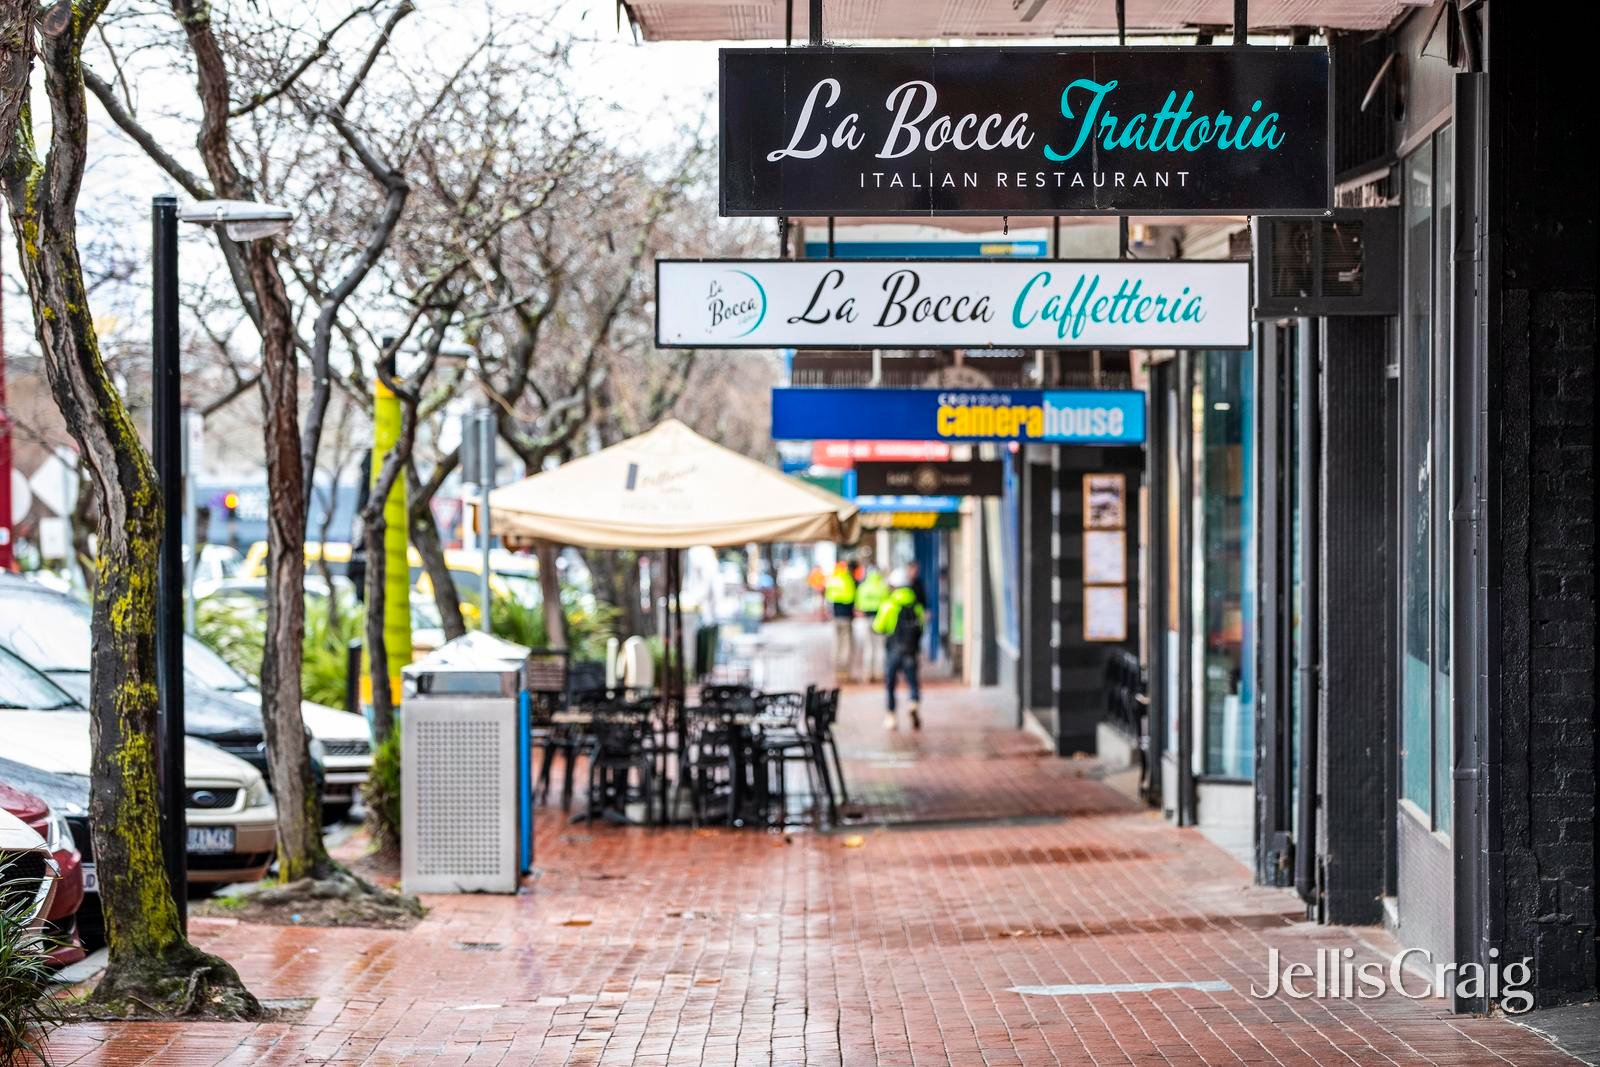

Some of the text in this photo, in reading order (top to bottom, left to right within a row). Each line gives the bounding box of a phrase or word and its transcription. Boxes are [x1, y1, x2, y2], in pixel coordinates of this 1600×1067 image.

[766, 78, 1286, 162] La Bocca Trattoria
[859, 171, 1190, 188] ITALIAN RESTAURANT
[707, 297, 758, 327] Bocca
[786, 269, 1207, 339] La Bocca Caffetteria
